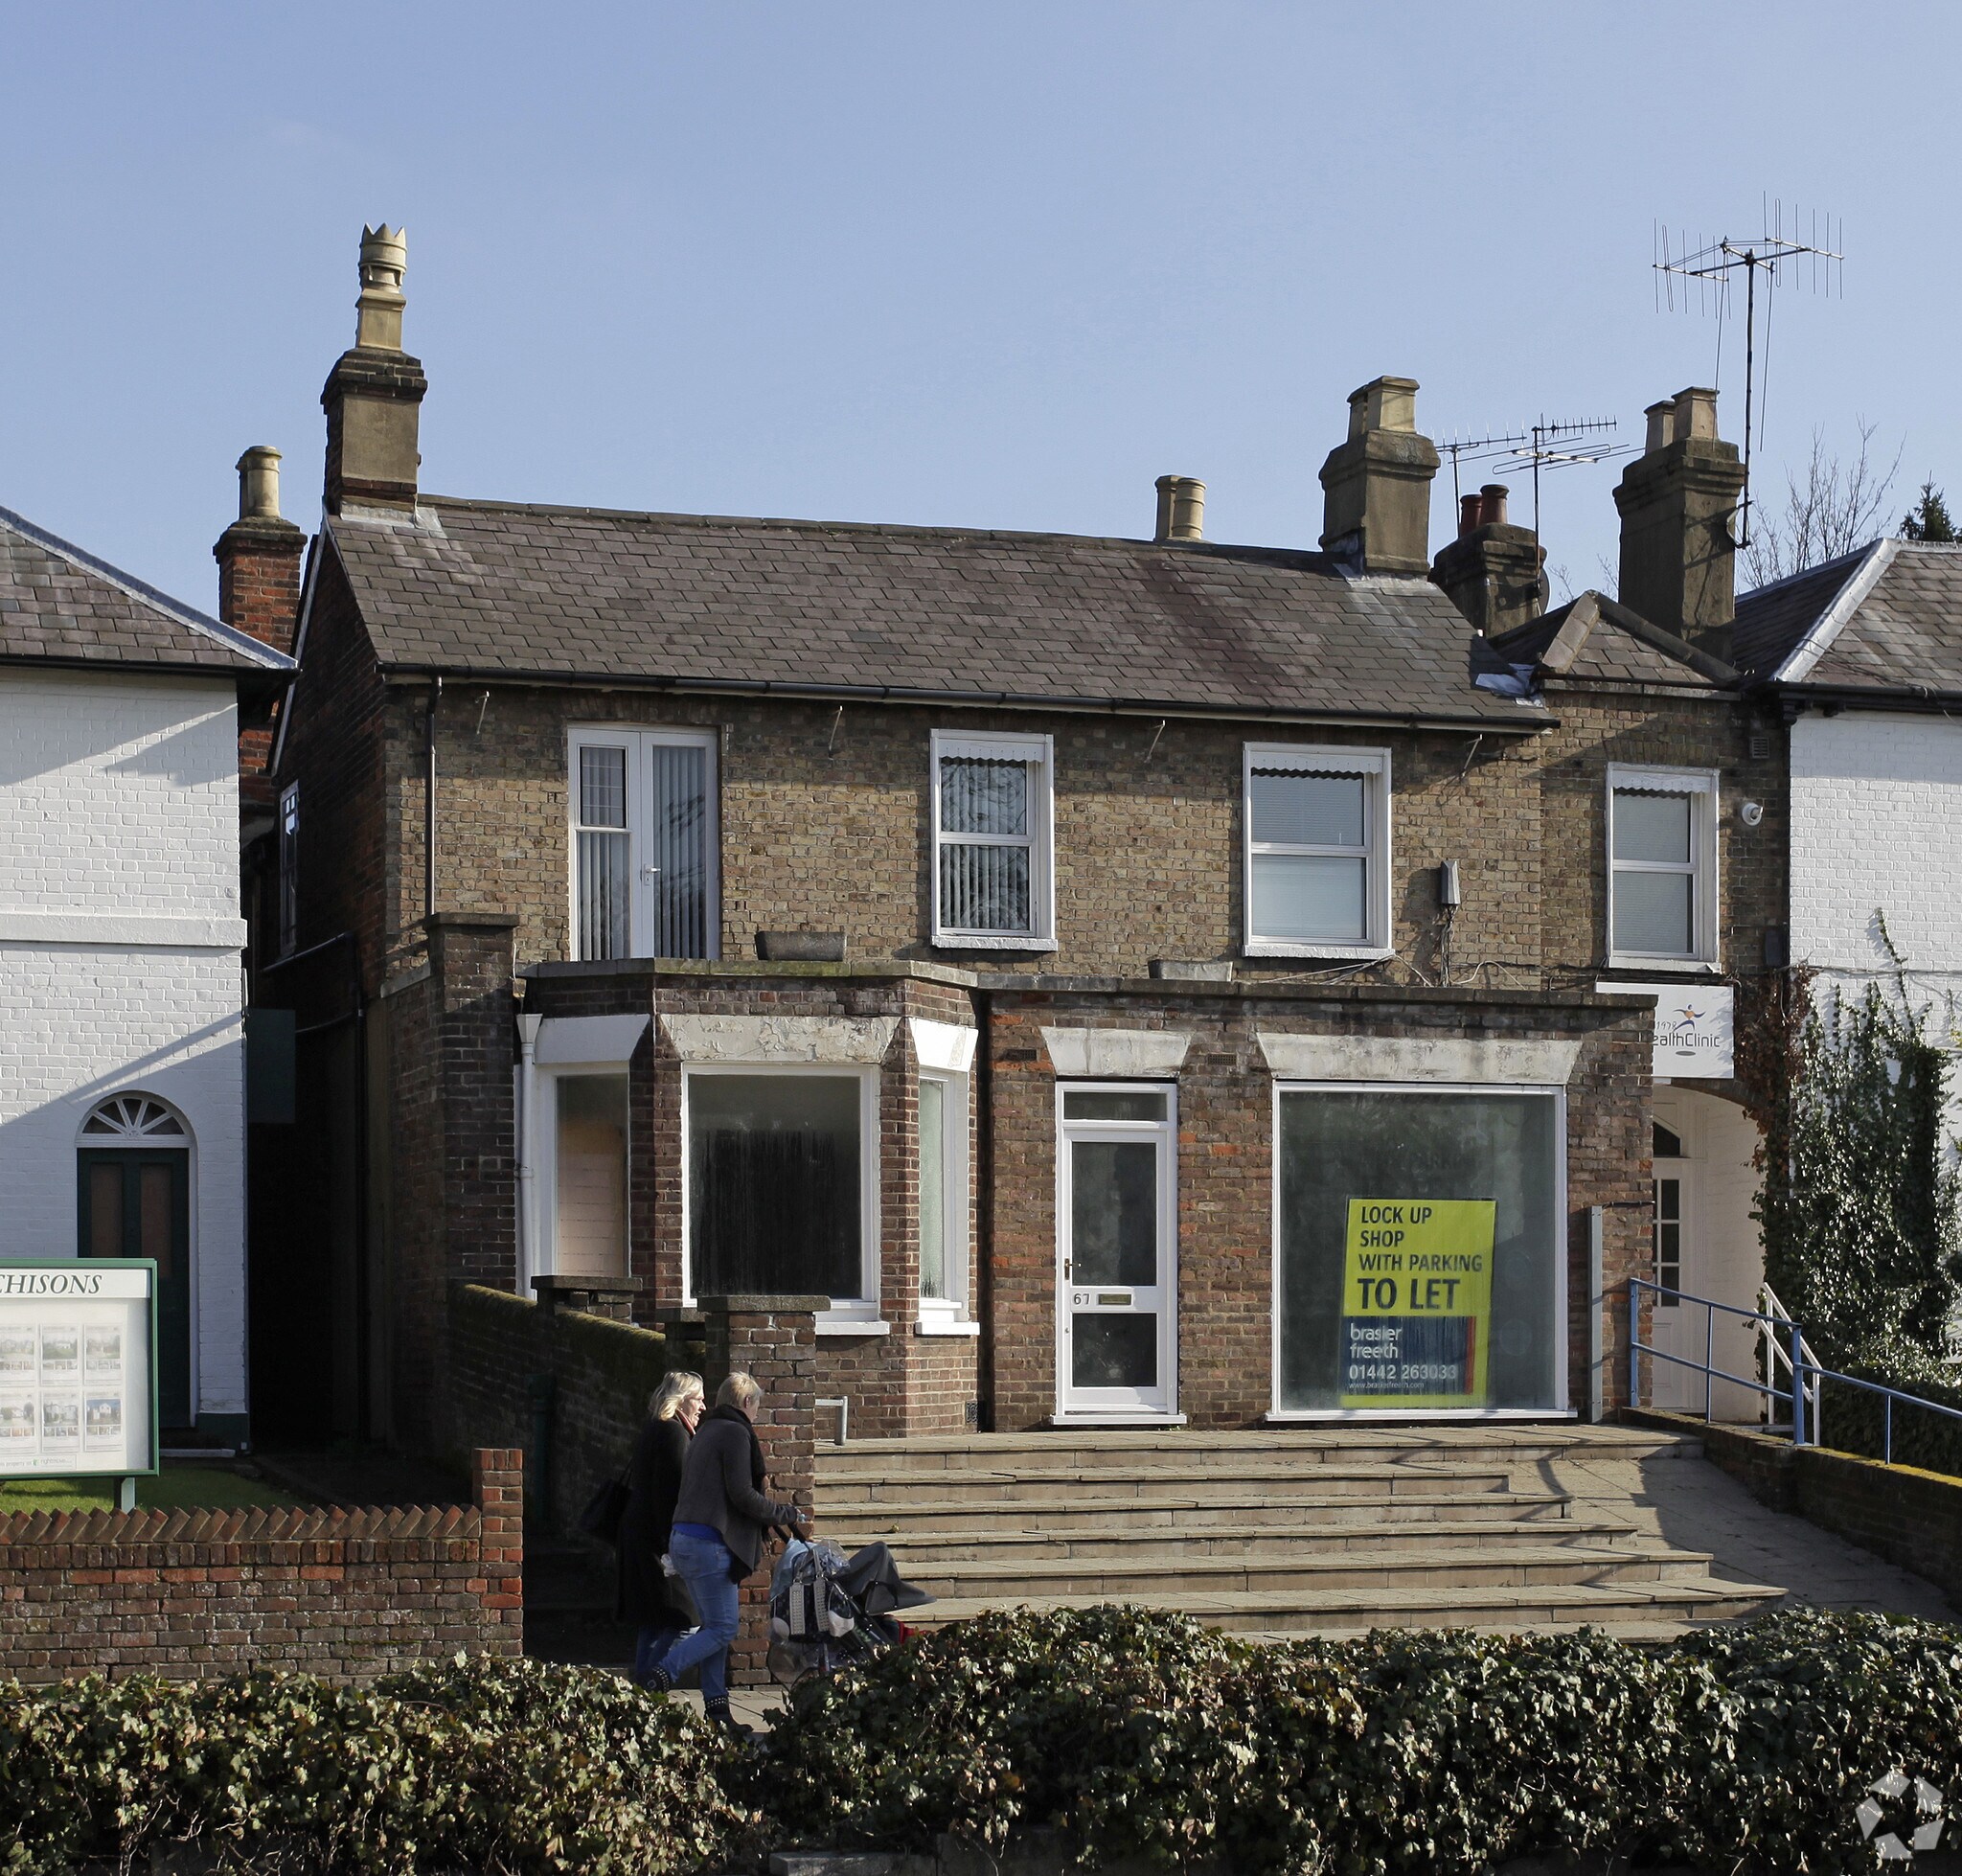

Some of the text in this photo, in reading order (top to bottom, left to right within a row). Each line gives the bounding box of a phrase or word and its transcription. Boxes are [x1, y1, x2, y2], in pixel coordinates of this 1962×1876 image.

[1361, 1206, 1432, 1224] LOCK UP
[1360, 1230, 1404, 1247] SHOP
[1358, 1253, 1483, 1272] WITH PARKING
[1073, 1293, 1090, 1305] 67
[1357, 1277, 1461, 1310] TO LET
[1350, 1322, 1403, 1341] brasier
[1350, 1342, 1399, 1359] freeth
[1349, 1364, 1397, 1380] 01442
